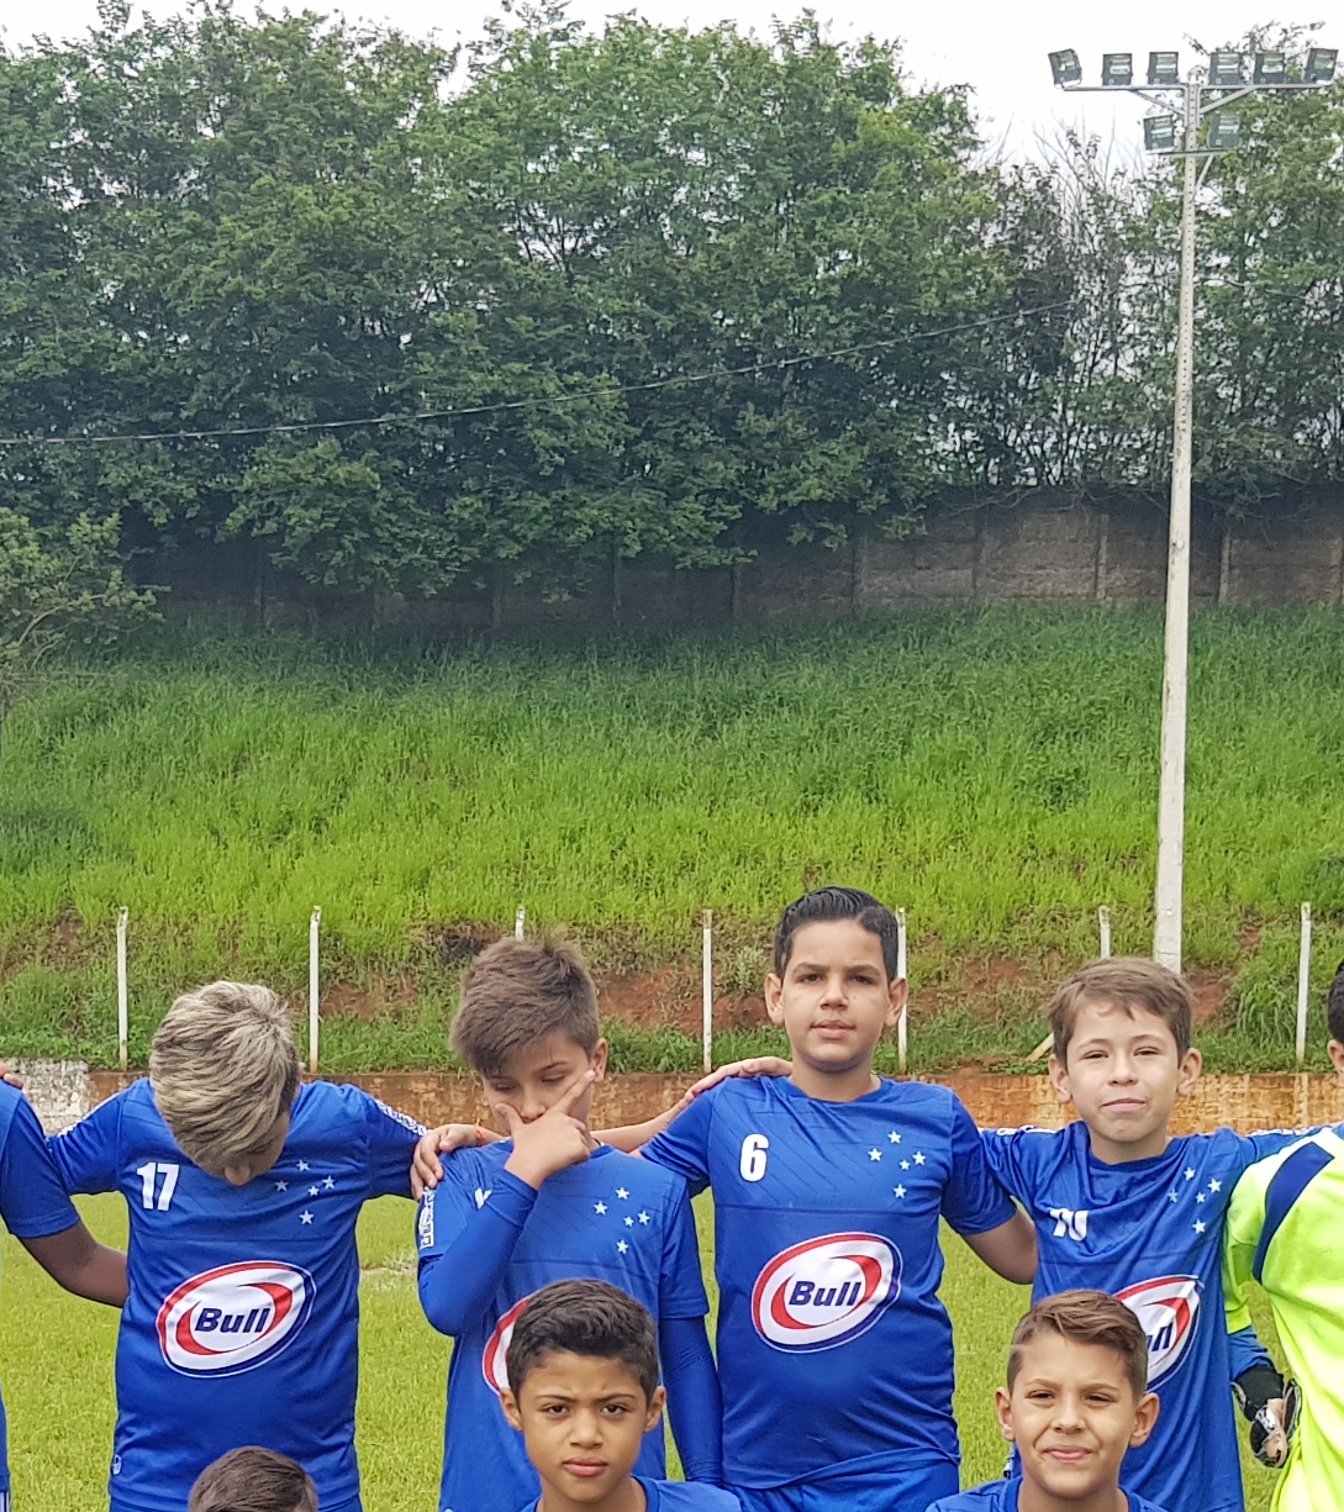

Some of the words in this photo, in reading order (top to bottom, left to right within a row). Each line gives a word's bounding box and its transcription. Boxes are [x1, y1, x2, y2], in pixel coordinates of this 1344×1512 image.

[741, 1133, 770, 1182] 6
[136, 1162, 180, 1211] 17
[789, 1280, 862, 1307] Bull
[196, 1306, 271, 1335] Bull
